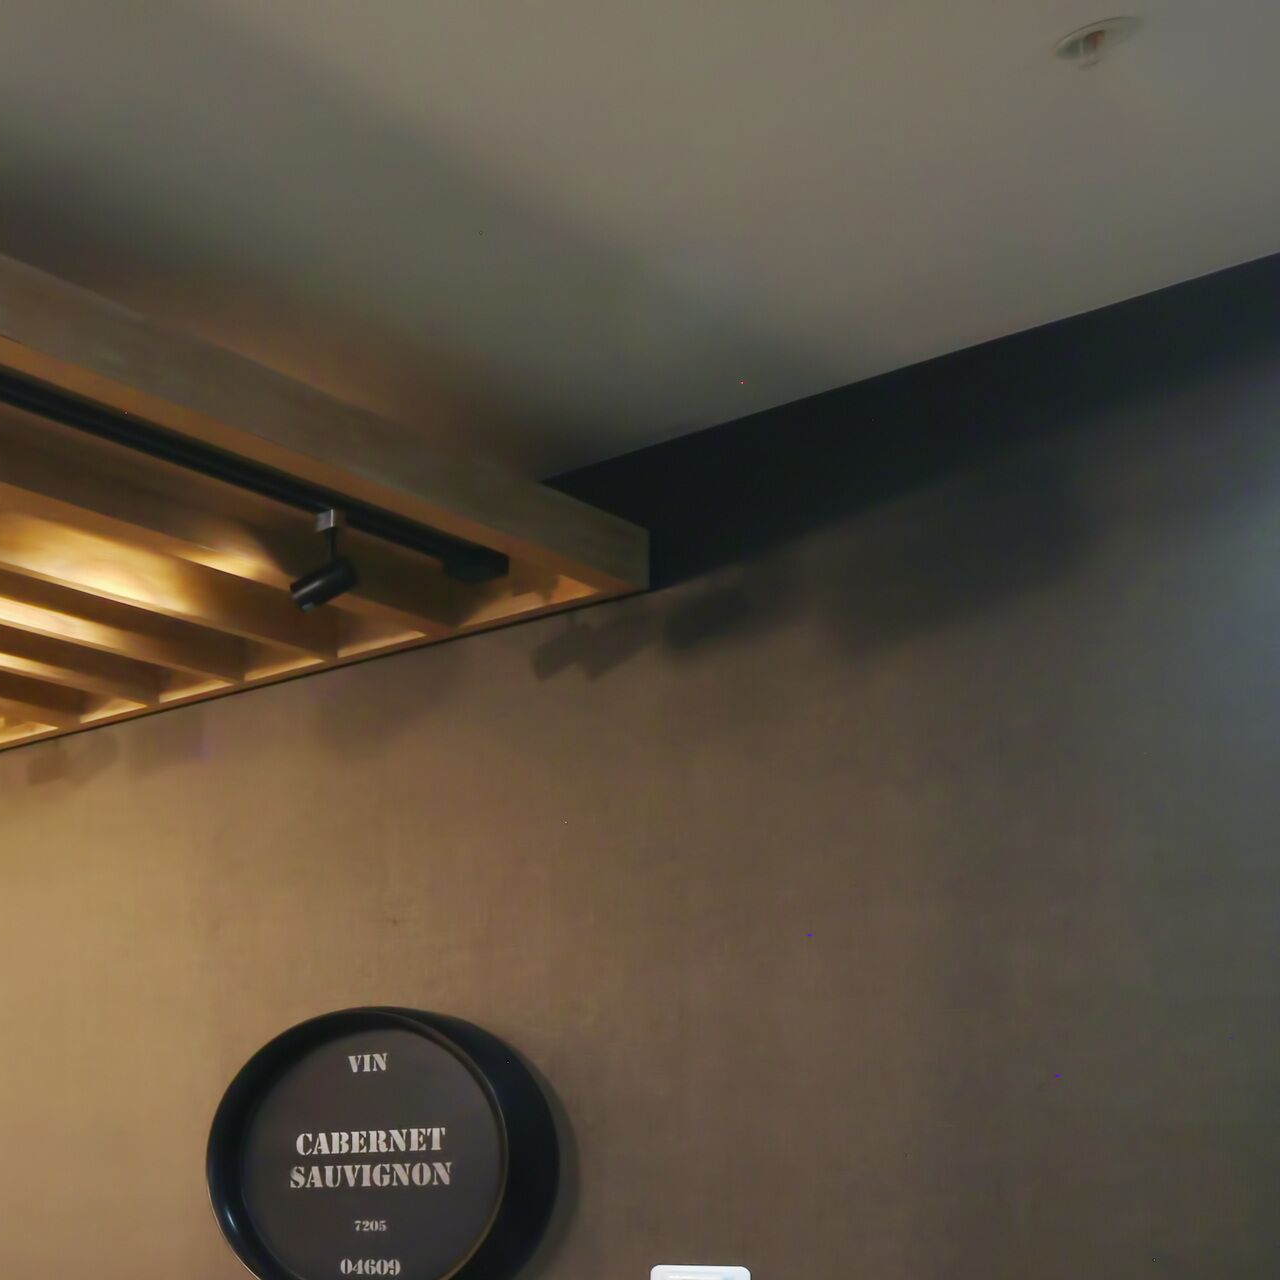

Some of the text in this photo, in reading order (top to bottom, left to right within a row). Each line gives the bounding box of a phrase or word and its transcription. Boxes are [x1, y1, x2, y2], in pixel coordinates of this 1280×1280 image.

[348, 1053, 388, 1073] VIN
[295, 1127, 446, 1157] CABERNET
[289, 1162, 452, 1190] SAUVIGNON
[354, 1219, 387, 1233] 7205
[340, 1258, 401, 1276] 04609
